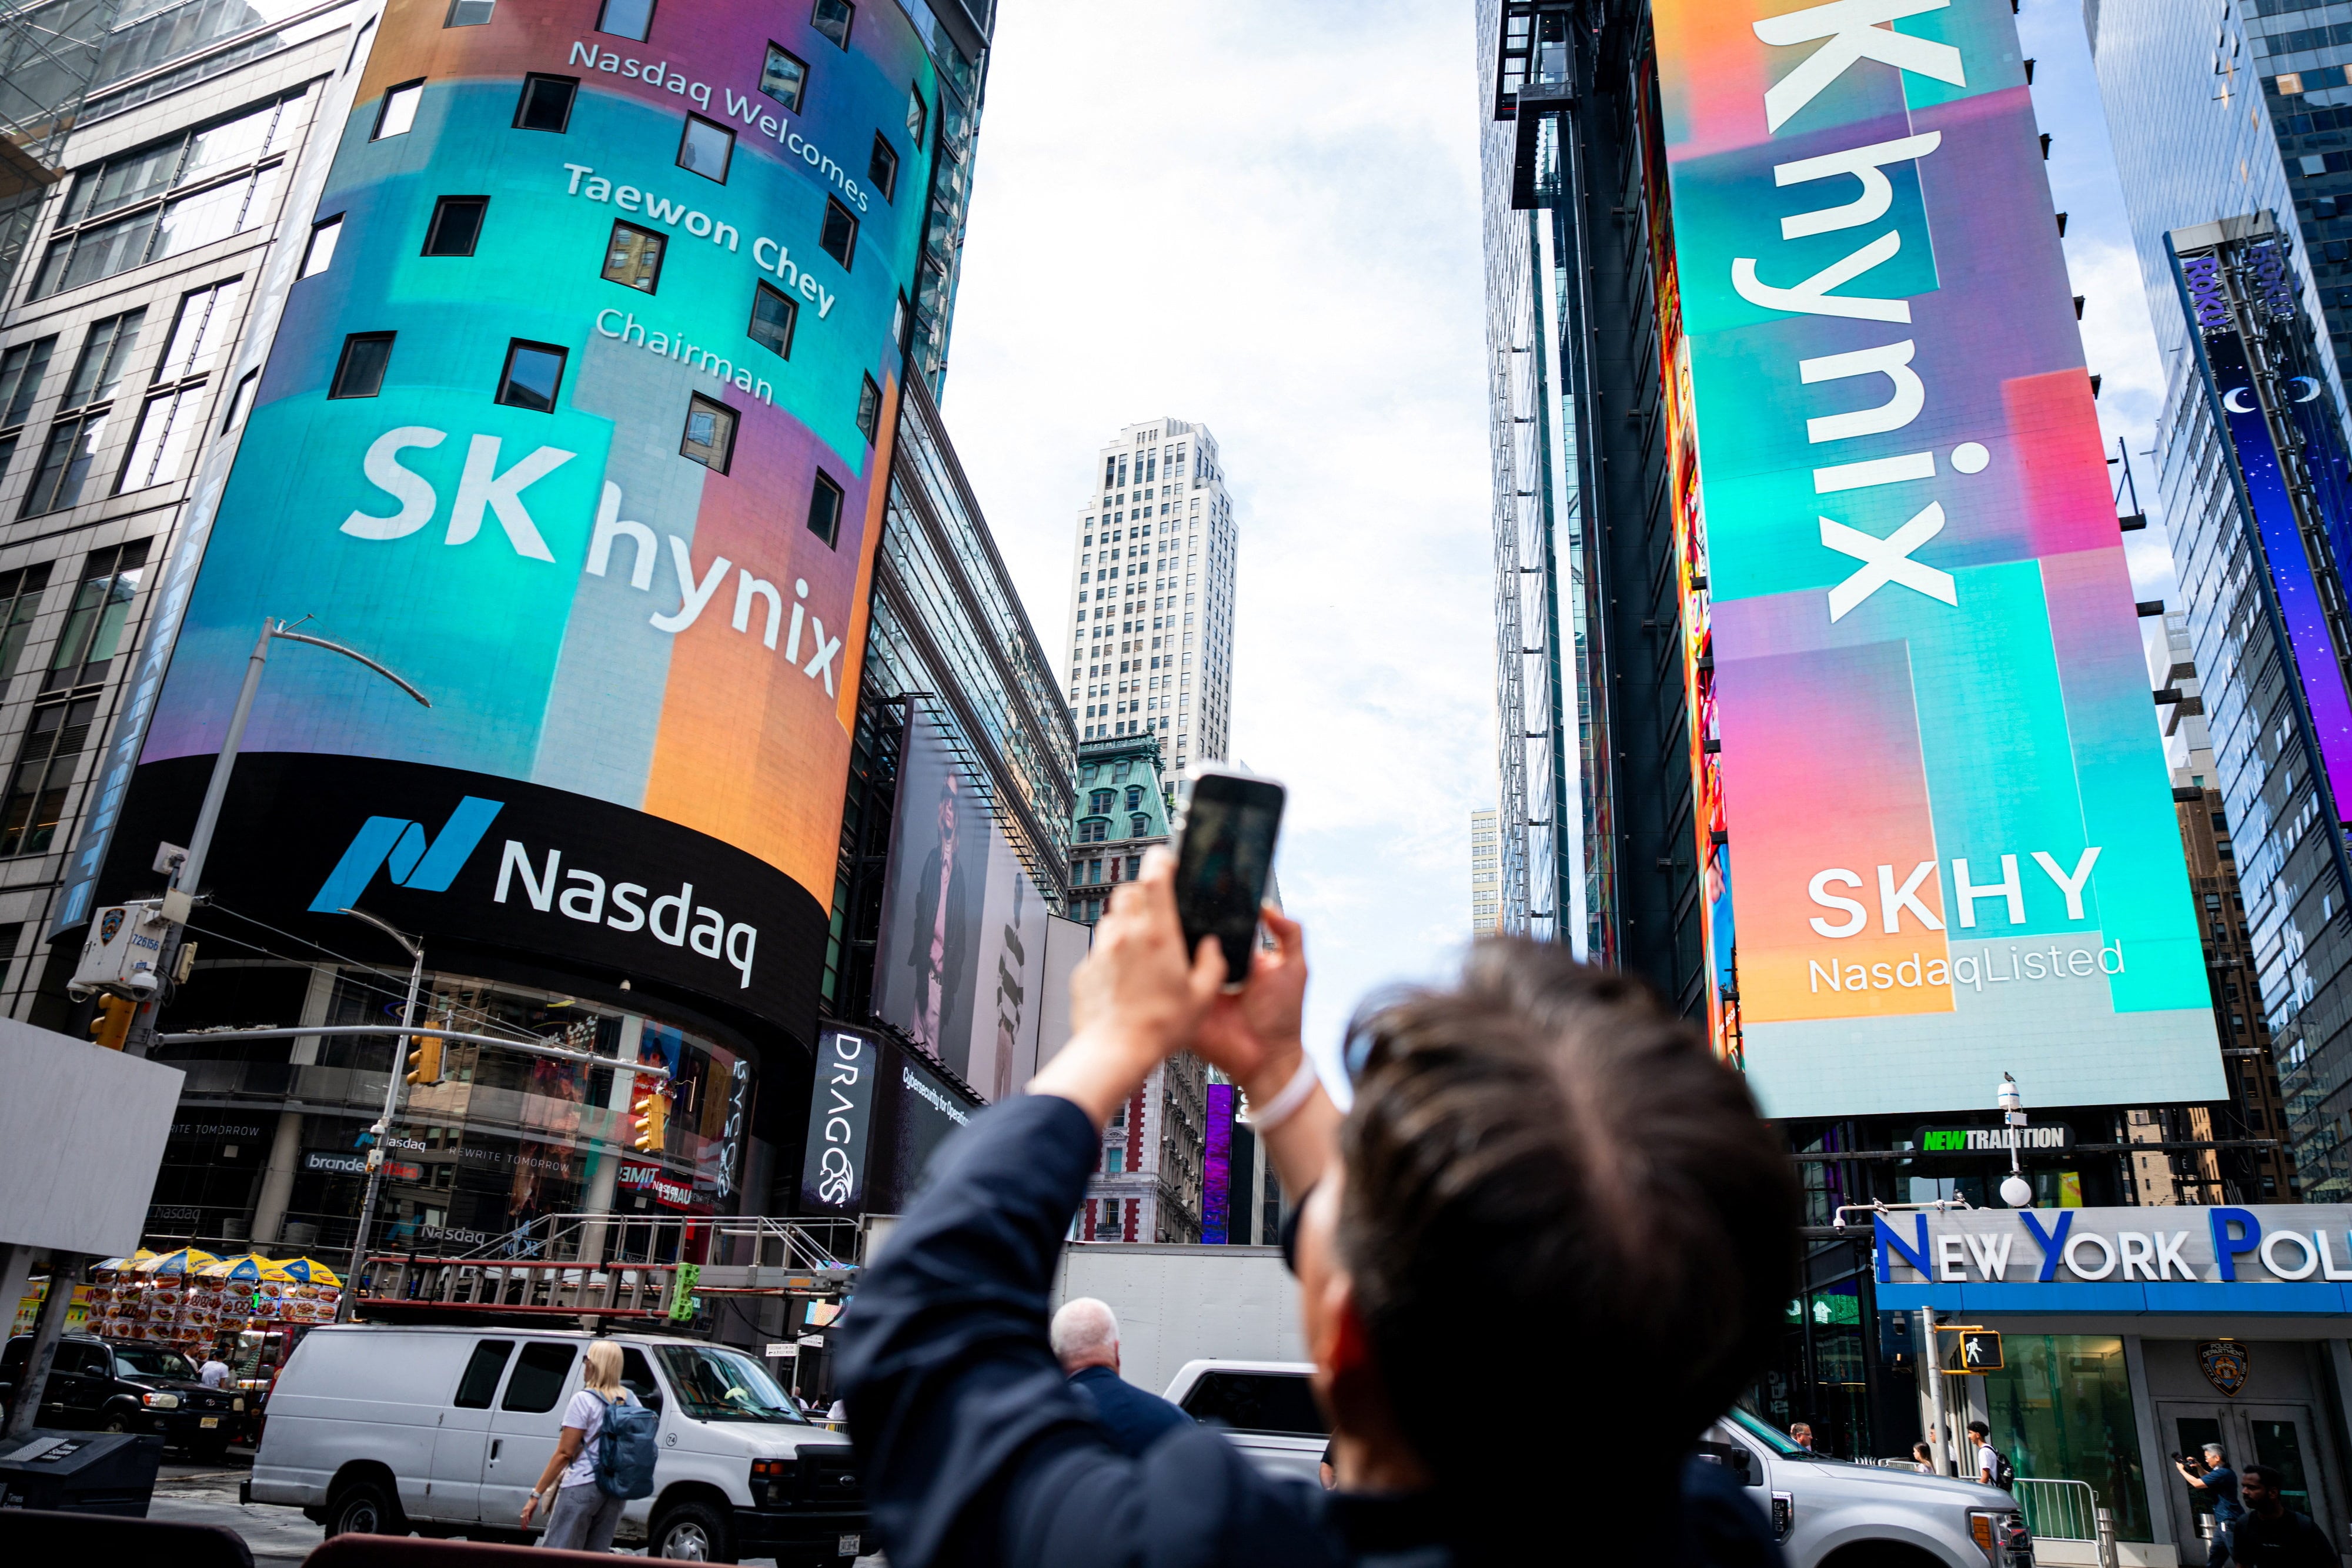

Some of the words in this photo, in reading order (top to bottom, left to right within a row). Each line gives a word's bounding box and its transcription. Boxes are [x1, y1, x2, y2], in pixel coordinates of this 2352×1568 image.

[568, 41, 711, 111] Nasdaq
[726, 88, 869, 213] Welcomes
[563, 163, 740, 252] Taewon
[753, 236, 836, 319] Chey
[596, 308, 774, 406] Chairman
[1731, 130, 1990, 624] hynix
[339, 426, 579, 564] SK
[586, 479, 841, 699] hynix
[1808, 847, 2103, 938] SKHY
[493, 840, 757, 989] Nasdaq
[132, 934, 159, 951] 726156
[903, 1066, 940, 1111] Cybersecurity
[196, 1125, 260, 1136] TOMORROW
[819, 1033, 862, 1205] DRAGOS
[309, 1154, 367, 1172] brande
[449, 1146, 502, 1162] REWRITE
[507, 1154, 570, 1172] TOMORROW
[155, 1206, 201, 1223] Nasdaq
[421, 1224, 485, 1248] Nasdaq
[1873, 1213, 2013, 1283] NEW
[2019, 1211, 2198, 1282] YORK
[2209, 1208, 2352, 1282] POL
[626, 1253, 647, 1264] Nasda
[2202, 1348, 2244, 1358] DEPARTMENT
[2204, 1363, 2214, 1376] CITY
[2235, 1376, 2244, 1387] NEW
